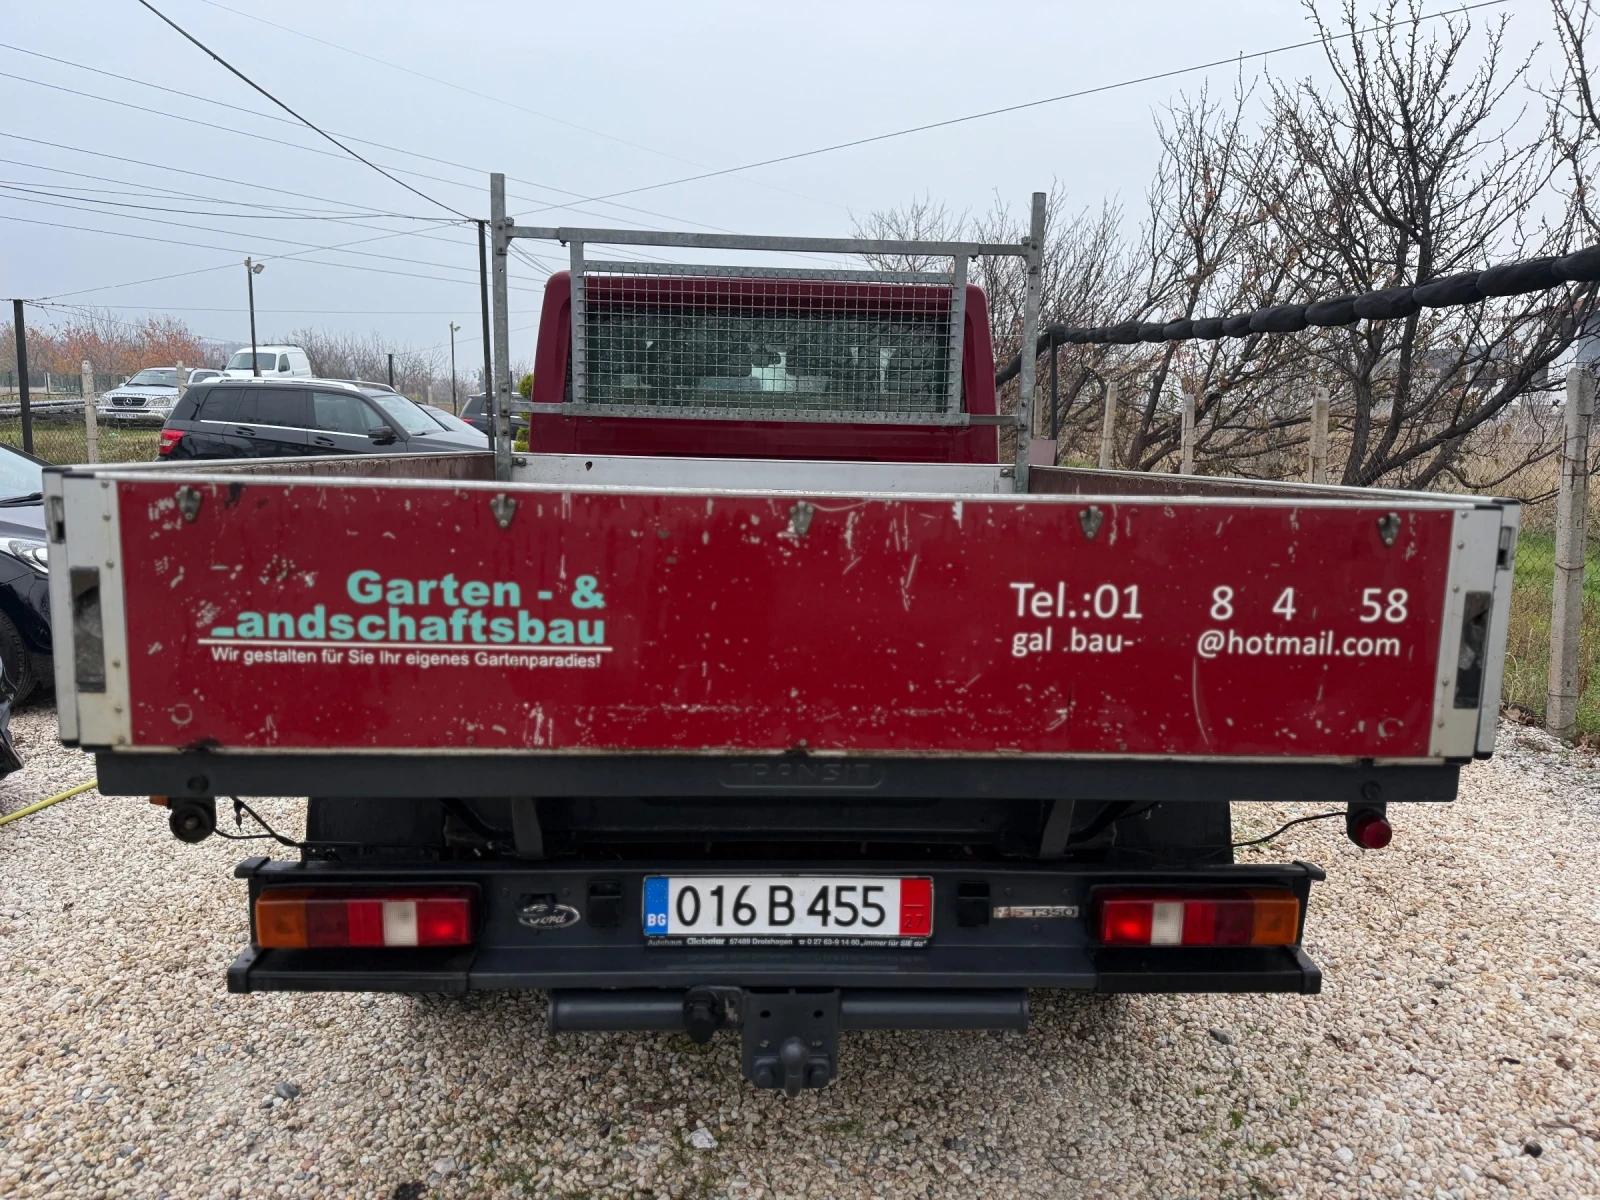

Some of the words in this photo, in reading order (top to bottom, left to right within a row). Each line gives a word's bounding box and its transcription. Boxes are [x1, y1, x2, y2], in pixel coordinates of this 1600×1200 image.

[347, 570, 520, 607] Garten
[571, 575, 606, 609] &
[1009, 582, 1143, 619] Tel.:01
[1210, 586, 1234, 621] 8
[1272, 587, 1296, 621] 4
[1359, 588, 1409, 623] 58
[211, 604, 605, 645] andschaftsbau
[1012, 627, 1052, 657] gal
[1197, 629, 1400, 658] @hotmail.com
[211, 647, 239, 662] Wir
[244, 648, 317, 666] gestalten
[321, 648, 344, 664] für
[348, 649, 374, 665] Sie
[380, 650, 401, 665] Ihr
[405, 652, 470, 669] eigenes
[474, 652, 601, 669] Gartenparadies!
[731, 763, 871, 783] TRANSIT
[675, 885, 757, 927] 016
[768, 885, 796, 927] B
[806, 885, 886, 927] 455
[647, 913, 667, 927] BG
[904, 913, 925, 928] 27
[647, 939, 683, 947] Autohaus
